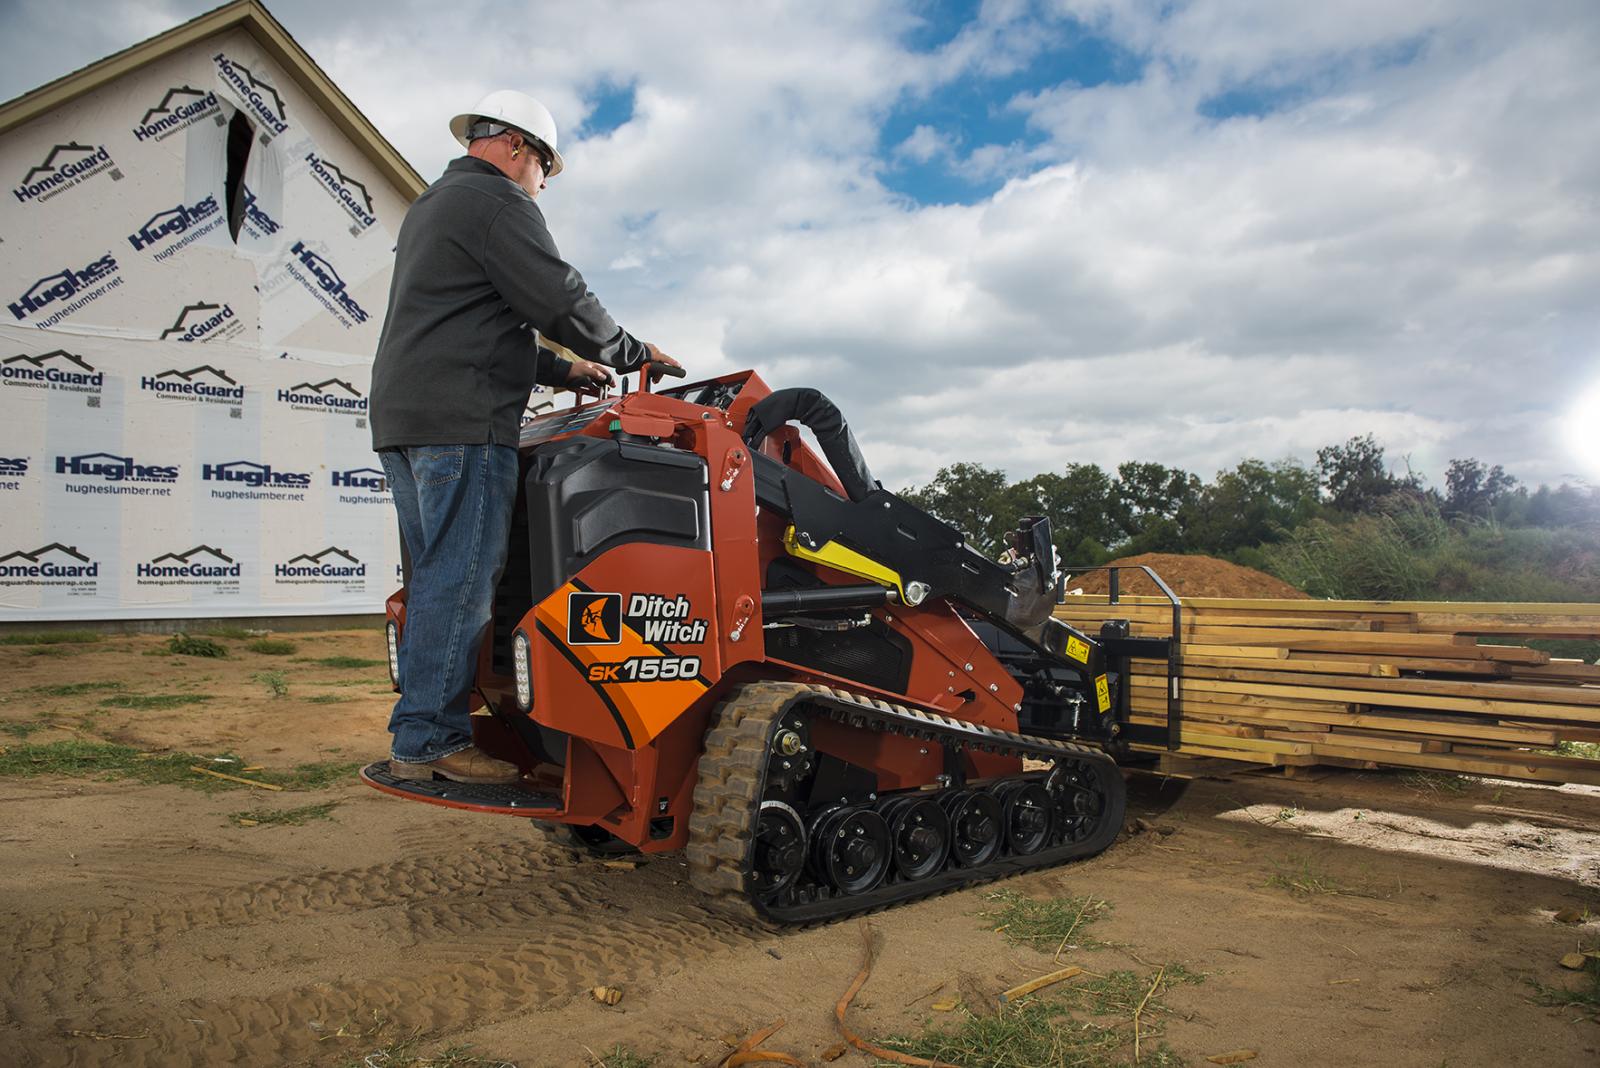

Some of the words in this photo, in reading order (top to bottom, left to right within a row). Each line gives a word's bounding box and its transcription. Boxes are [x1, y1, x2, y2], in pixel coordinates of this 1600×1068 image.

[213, 53, 288, 134] HomeGuard
[133, 91, 218, 142] HomeGuard
[12, 146, 110, 202] HomeGuard
[305, 152, 376, 227] HomeGuard
[128, 195, 218, 251] Hughes
[153, 215, 226, 262] hugheslumber.net
[7, 254, 117, 320] Hughes
[290, 241, 369, 322] Hughes
[36, 276, 124, 330] hugheslumber.net
[285, 262, 353, 330] hugheslumber.net
[178, 304, 234, 342] eGuard
[0, 363, 103, 386] omeGuard
[141, 376, 244, 399] HomeGuard
[277, 389, 368, 409] HomeGuard
[56, 456, 179, 481] Hughes
[203, 464, 311, 488] Hughes
[65, 483, 171, 496] hugheslumber.net
[332, 471, 391, 492] Hug
[211, 489, 305, 502] hugheslumber.net
[137, 563, 240, 577] HomeGuard
[275, 563, 365, 576] HomeGuard
[628, 595, 689, 618] Ditch
[644, 620, 706, 642] Witch
